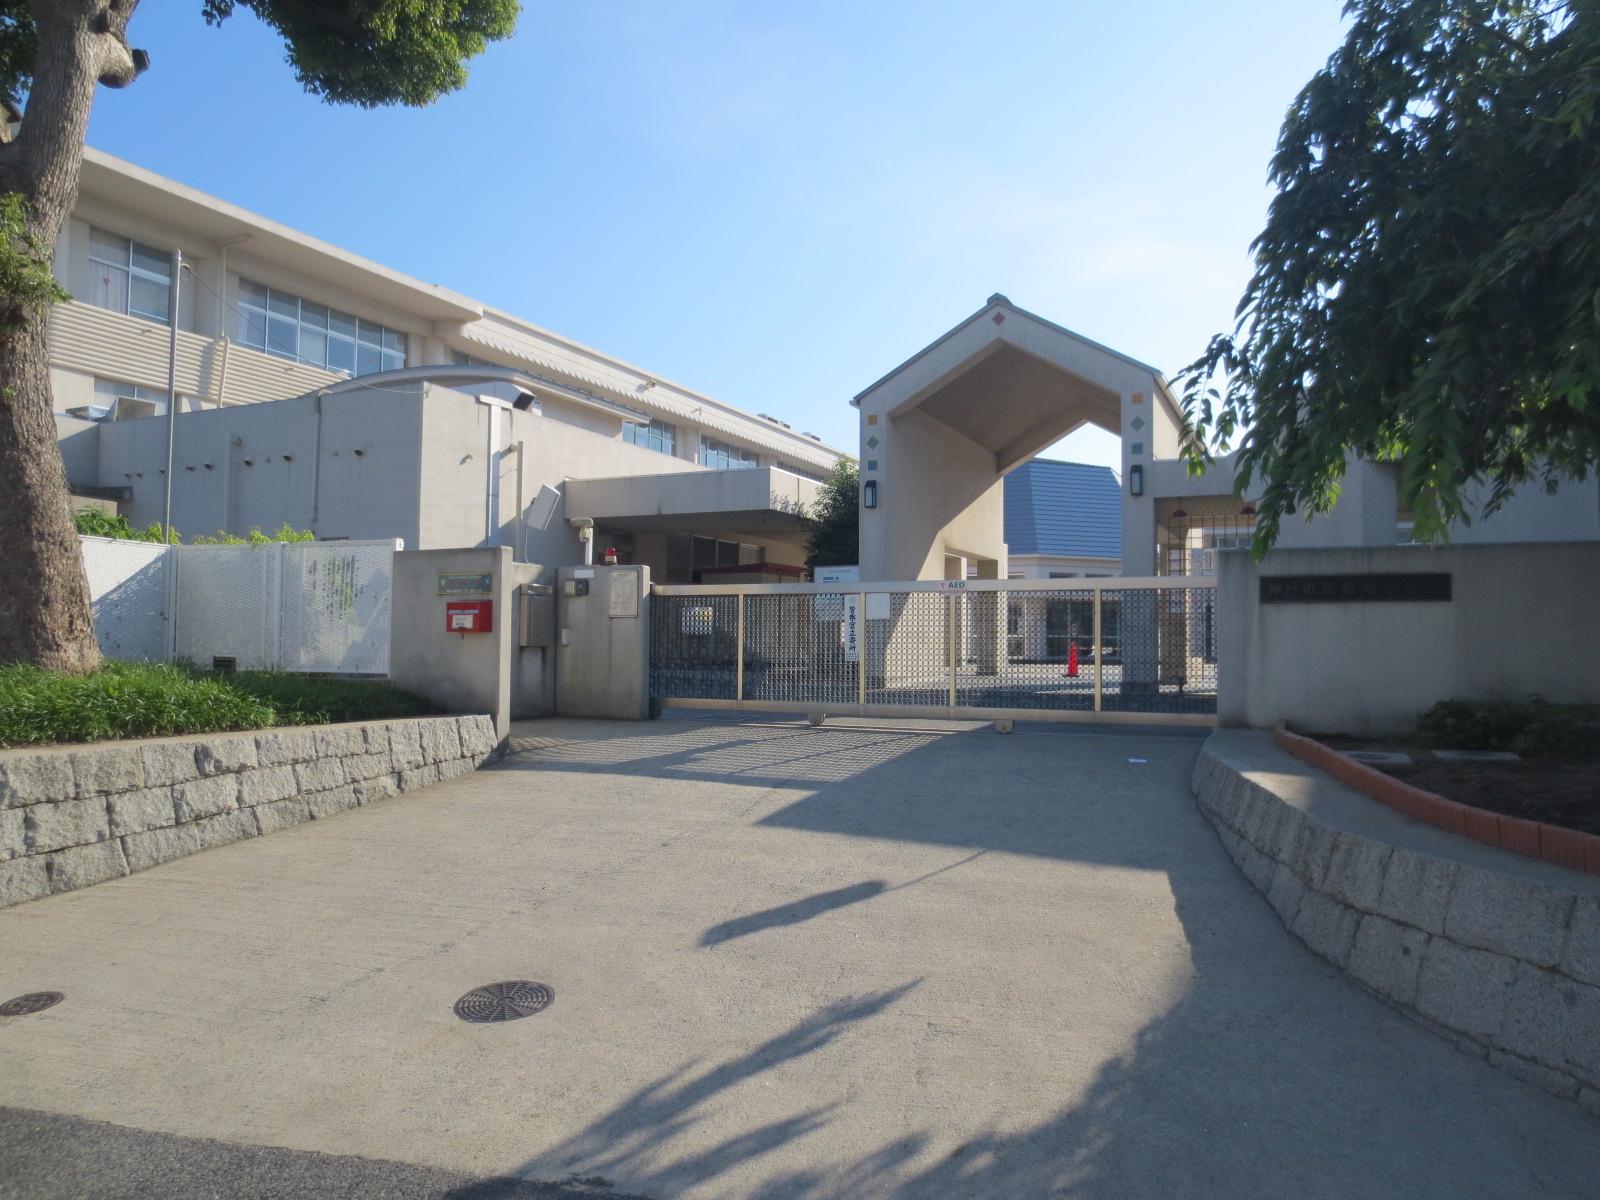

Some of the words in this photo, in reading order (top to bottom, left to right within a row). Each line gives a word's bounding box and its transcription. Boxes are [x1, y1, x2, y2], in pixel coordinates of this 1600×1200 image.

[948, 581, 965, 589] AED
[848, 605, 857, 653] 警察官立寄所
